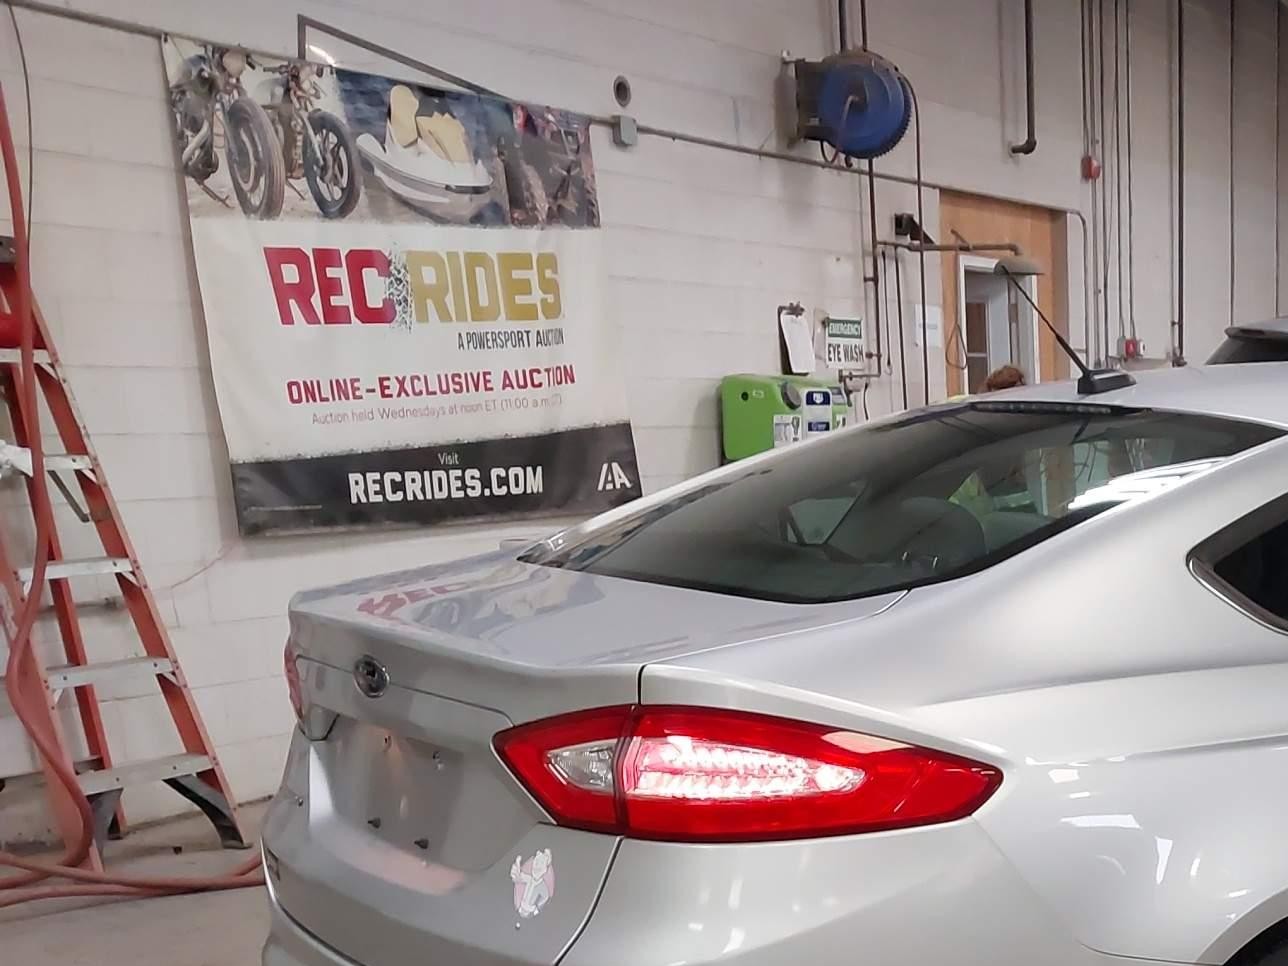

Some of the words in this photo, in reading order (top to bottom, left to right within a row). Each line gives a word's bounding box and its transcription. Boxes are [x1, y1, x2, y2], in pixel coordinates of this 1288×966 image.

[830, 322, 861, 336] EMERGENCY
[458, 332, 464, 350] A
[466, 330, 531, 350] POWERSPORT
[536, 328, 565, 347] AUCTION
[828, 343, 841, 362] EYE
[843, 343, 865, 362] WASH
[287, 371, 494, 404] ONLINE-EXCLUSIVE
[502, 364, 576, 391] AUCTION
[312, 411, 349, 424] Auction
[351, 407, 374, 421] held
[438, 452, 460, 465] Visit
[349, 465, 543, 504] RECRIDES.COM
